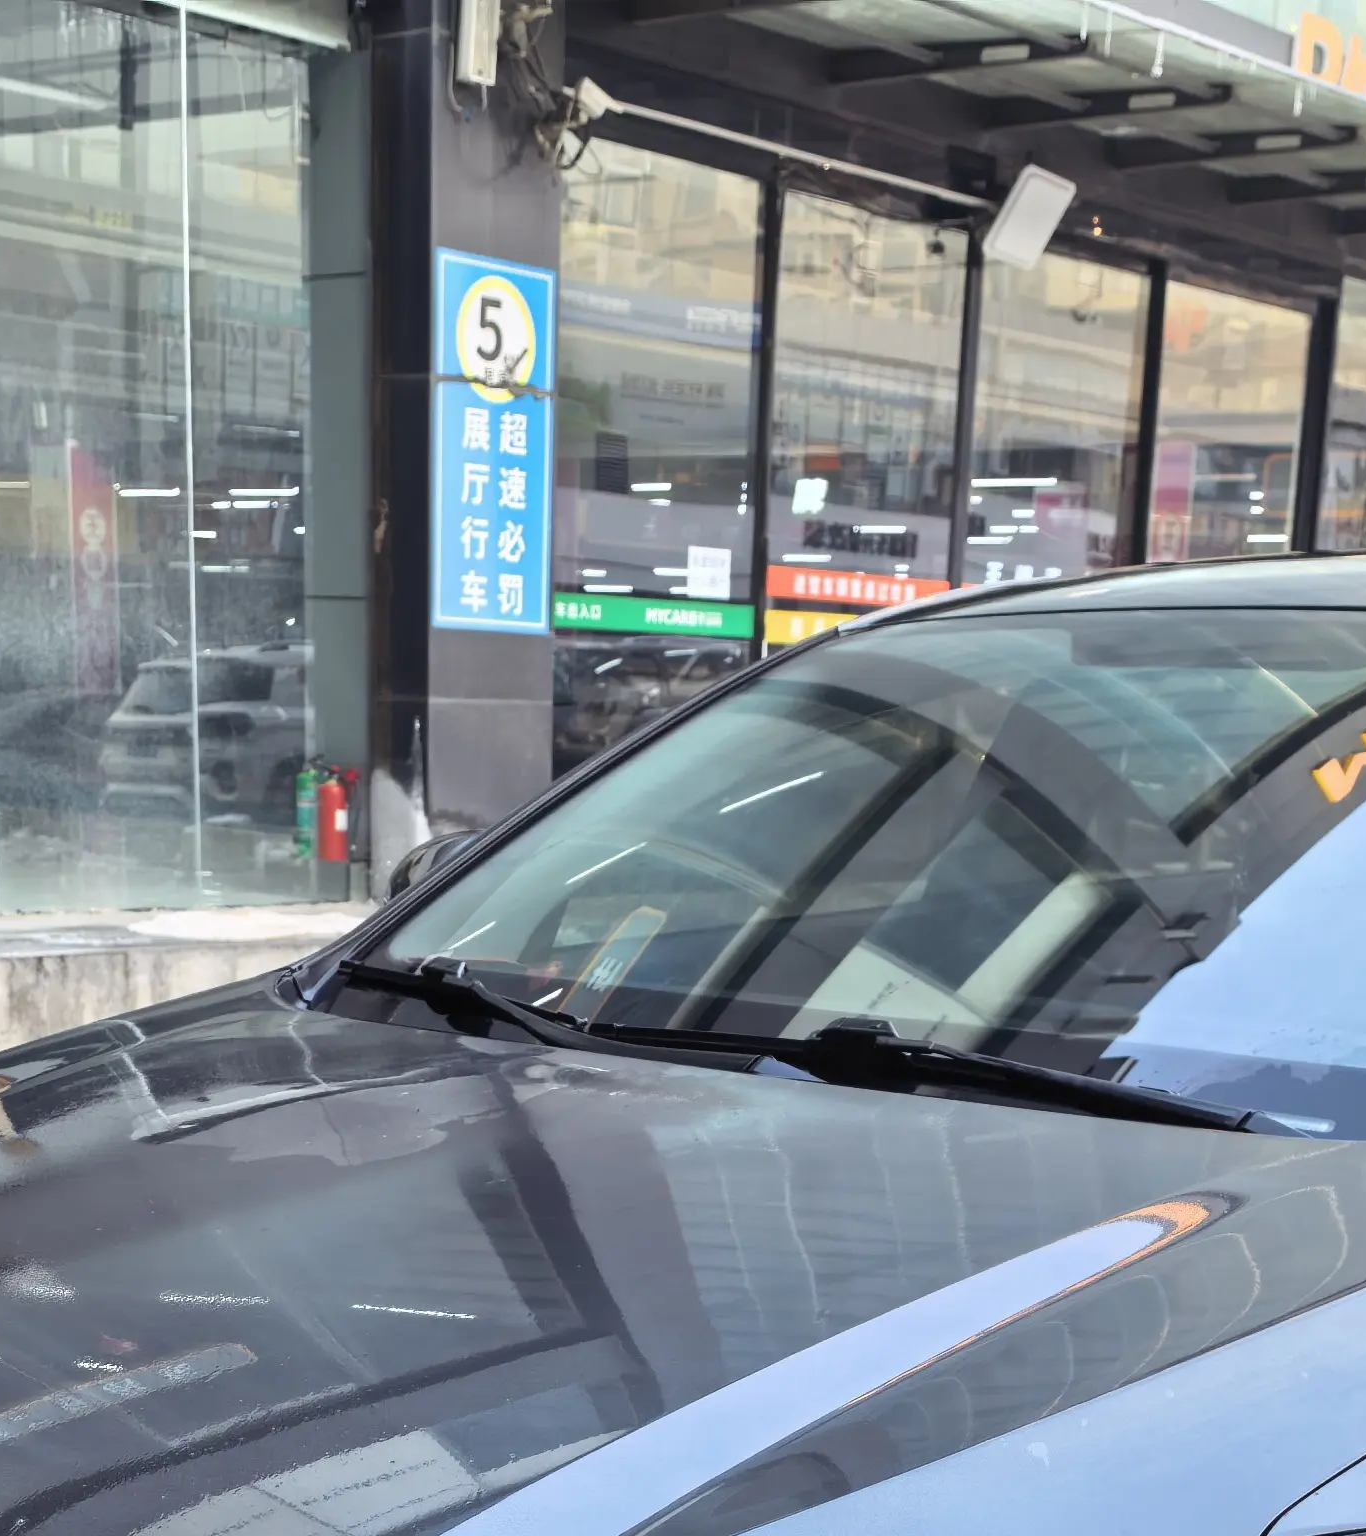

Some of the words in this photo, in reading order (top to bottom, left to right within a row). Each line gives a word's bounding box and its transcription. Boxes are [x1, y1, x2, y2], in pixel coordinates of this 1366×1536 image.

[476, 294, 502, 362] 5
[460, 407, 491, 613] 展厅行车
[497, 411, 528, 616] 超速必罚
